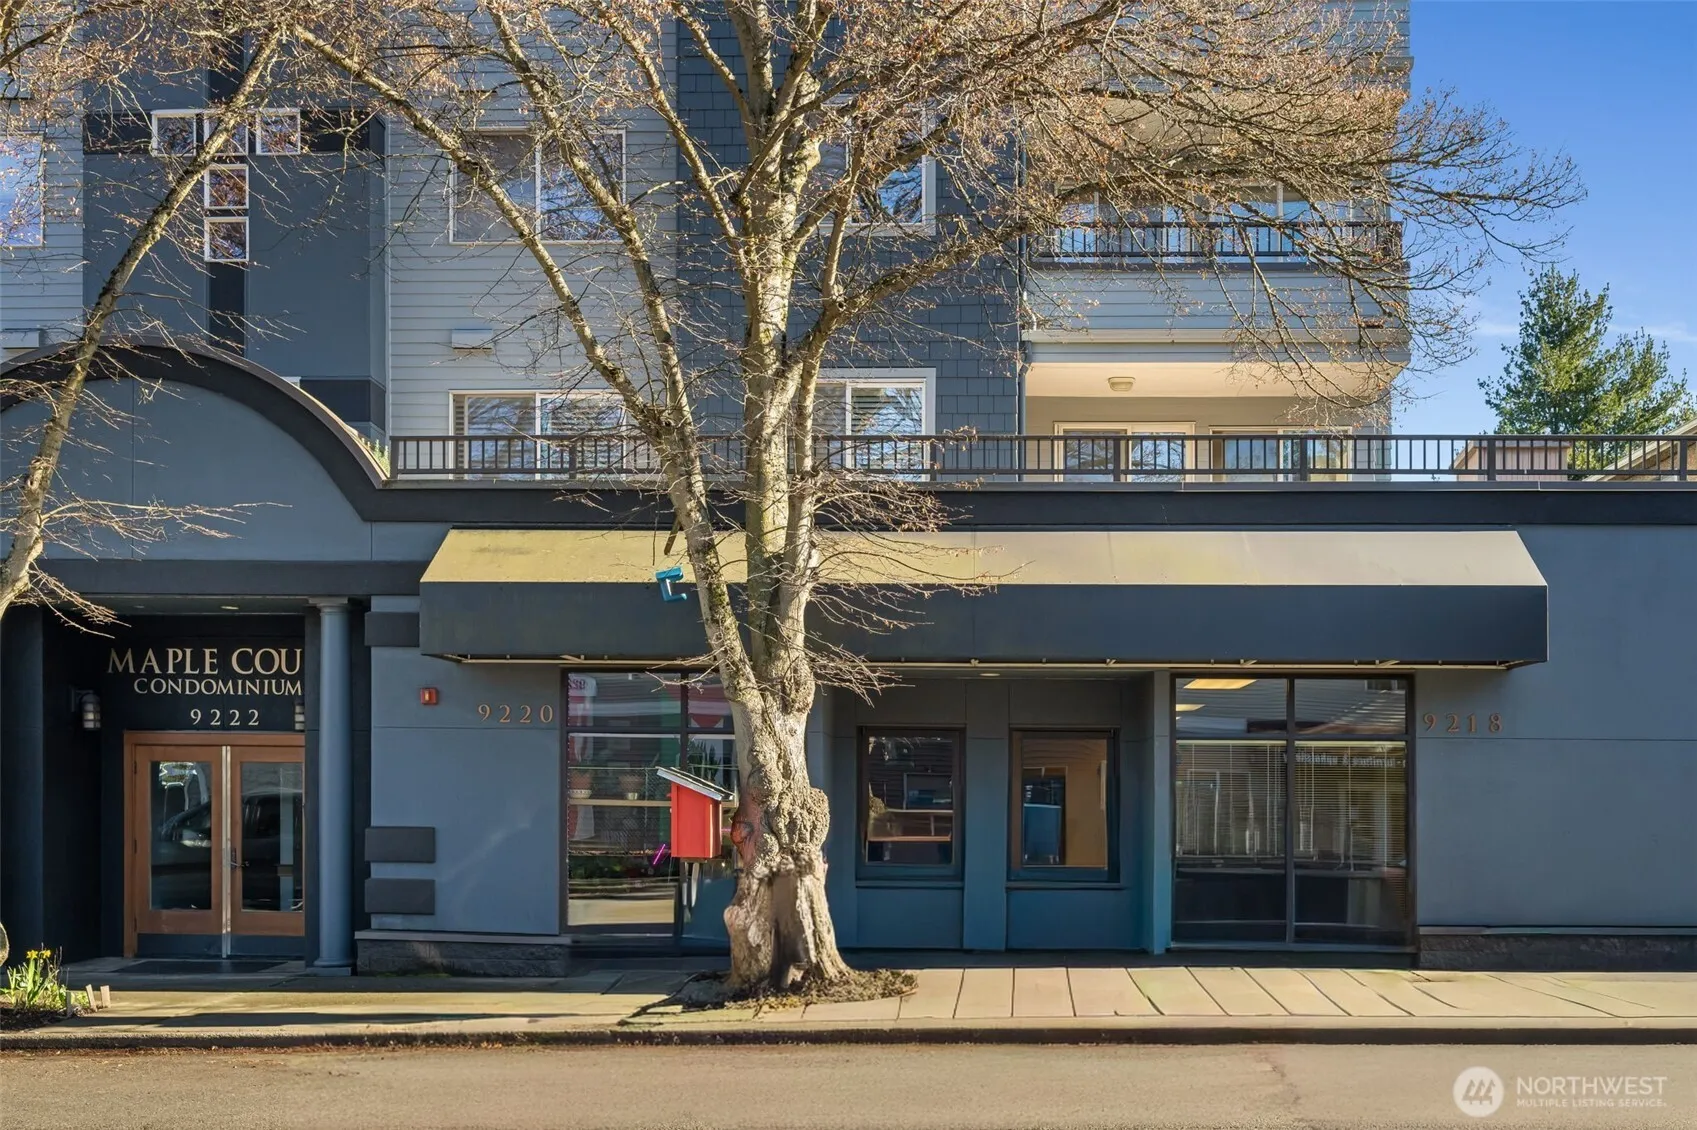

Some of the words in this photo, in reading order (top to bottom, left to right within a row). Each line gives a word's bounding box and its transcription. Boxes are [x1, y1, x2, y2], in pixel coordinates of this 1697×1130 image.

[107, 648, 219, 674] MAPLE
[133, 678, 303, 696] CONDOMINIUM
[190, 709, 260, 726] 9222
[477, 704, 554, 723] 9220
[1423, 713, 1503, 733] 9218
